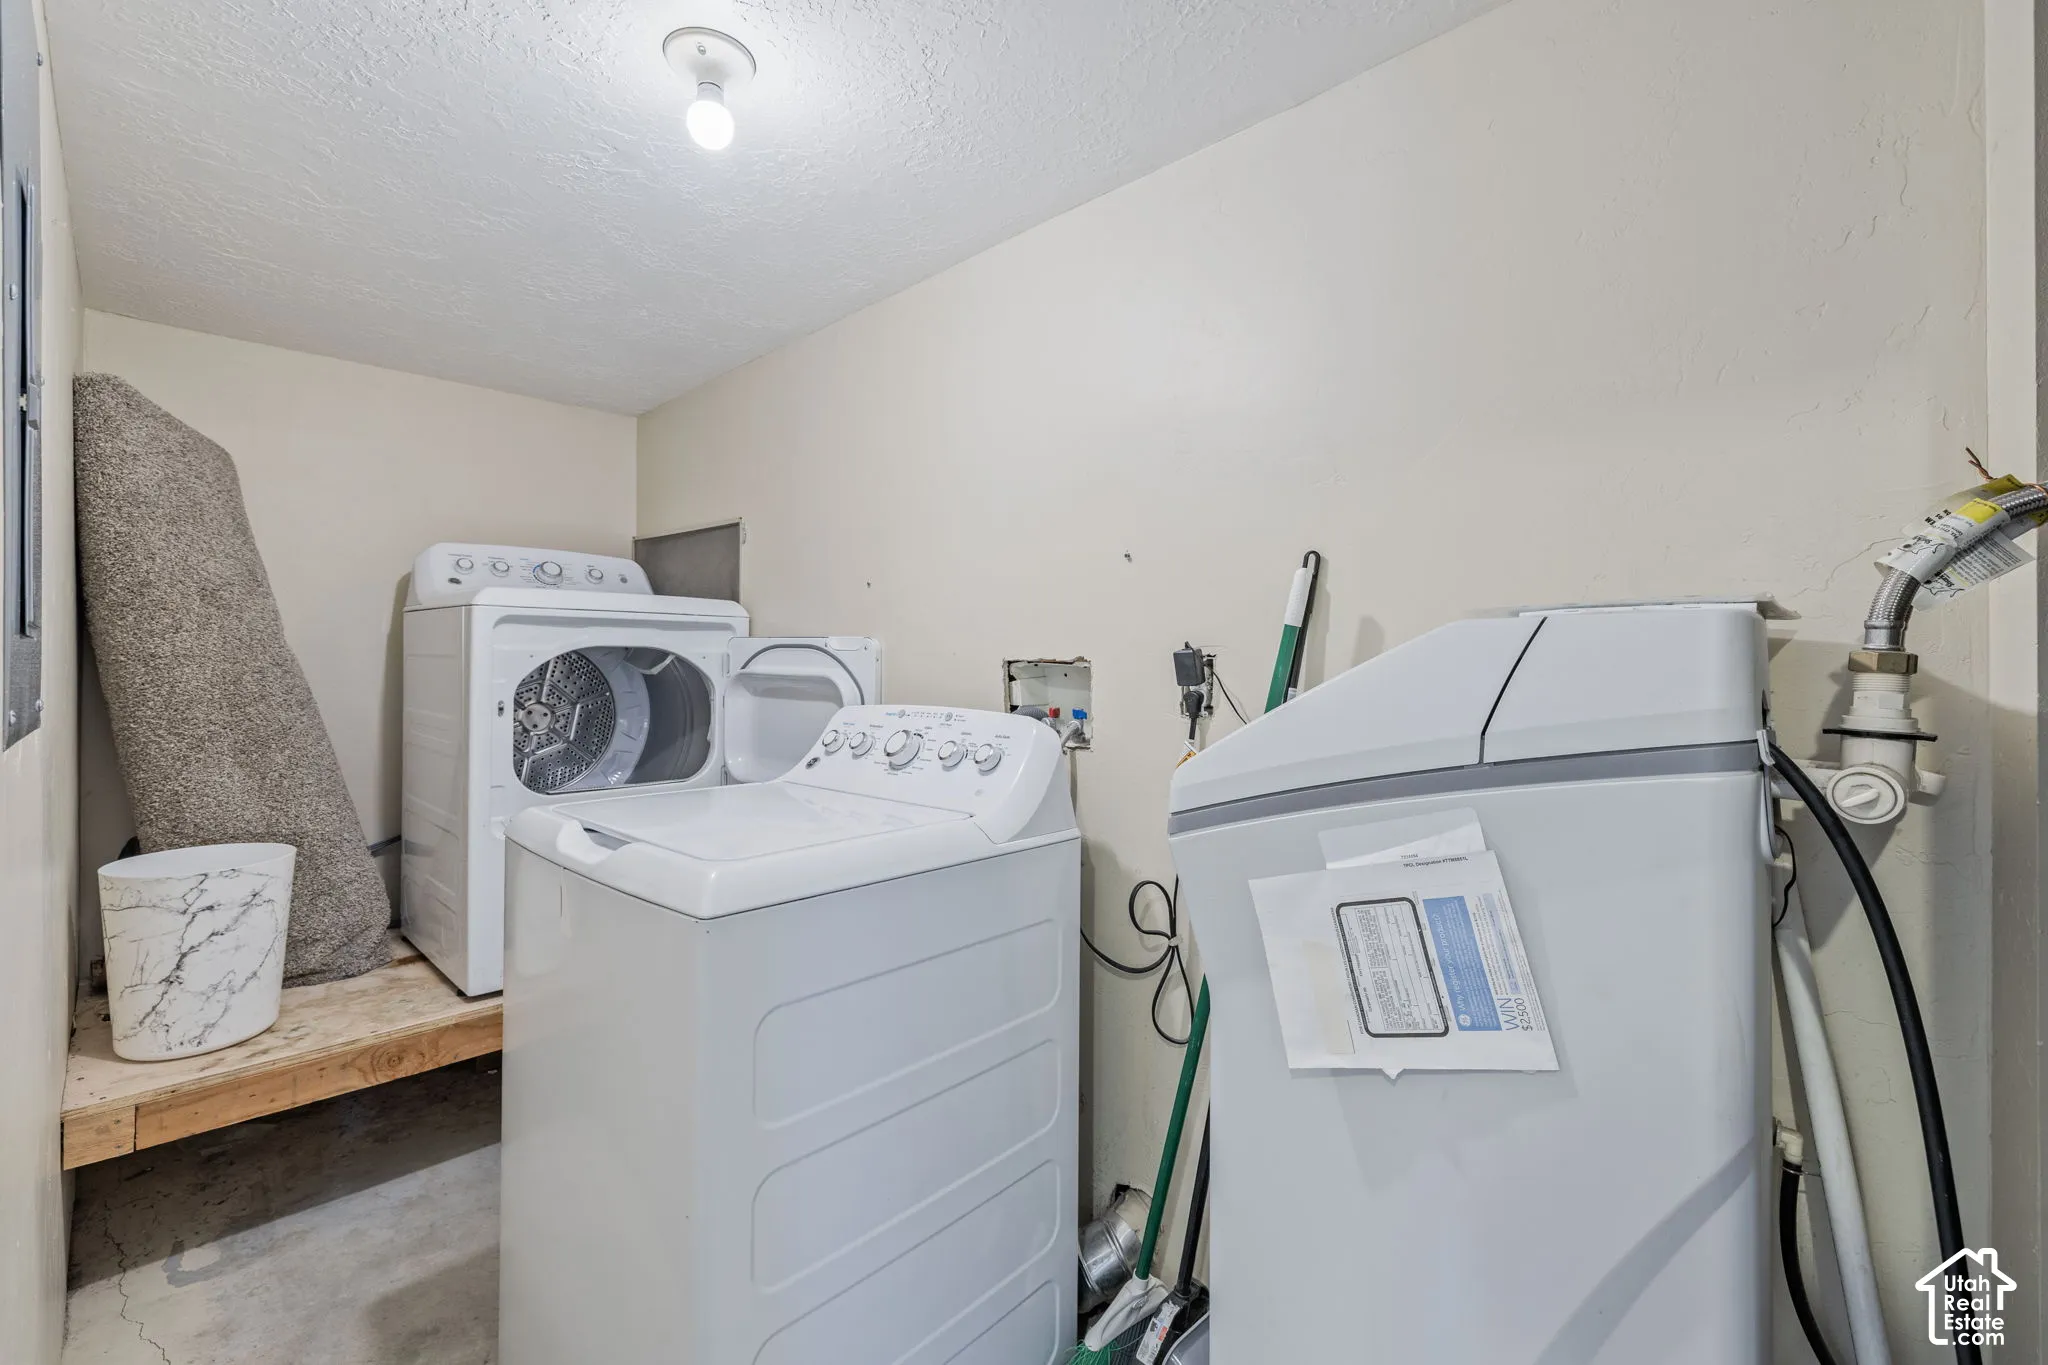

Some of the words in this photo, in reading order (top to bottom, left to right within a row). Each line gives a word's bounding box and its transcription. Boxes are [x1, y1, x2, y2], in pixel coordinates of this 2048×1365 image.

[1443, 947, 1454, 966] your
[1449, 966, 1461, 993] register
[1456, 995, 1466, 1010] Why
[1497, 998, 1520, 1030] WIN
[1514, 998, 1532, 1031] $2,500
